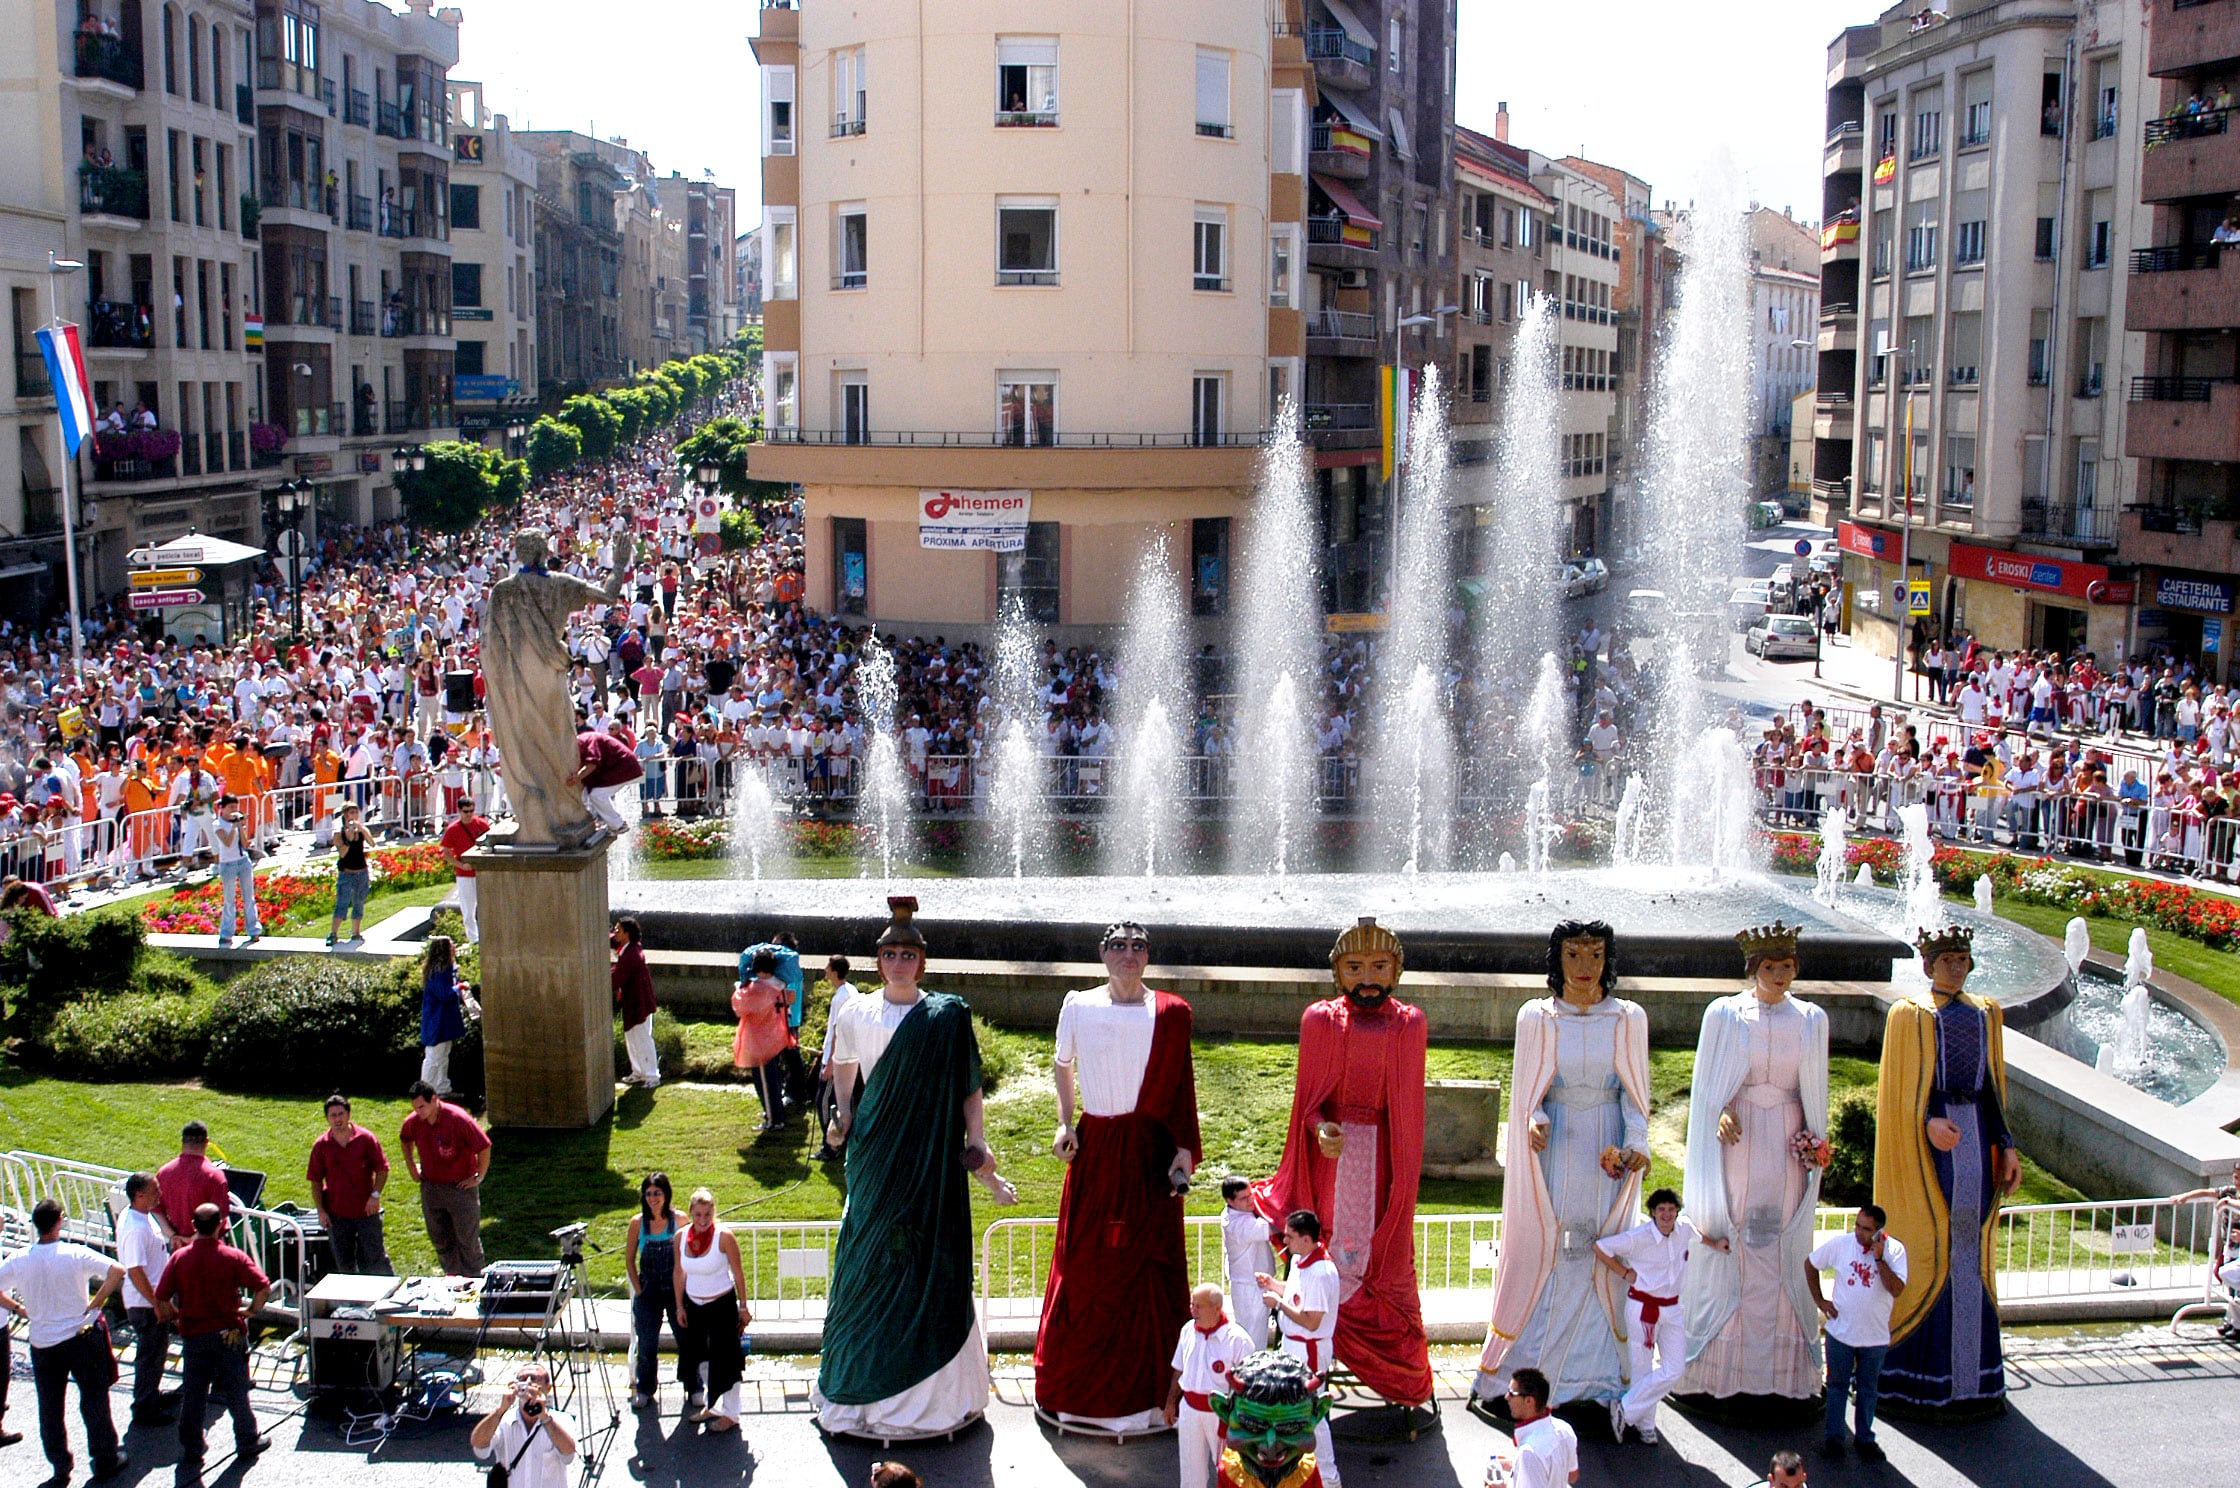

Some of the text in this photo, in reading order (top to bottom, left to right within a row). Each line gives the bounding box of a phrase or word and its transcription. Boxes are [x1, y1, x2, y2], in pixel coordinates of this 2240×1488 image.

[923, 536, 1024, 549] PROXIMA APERTURA
[1998, 562, 2057, 583] EROSKI center
[2162, 578, 2222, 598] CAFETERIA
[158, 595, 184, 603] antiguo
[2156, 591, 2229, 611] RESTAURANTE
